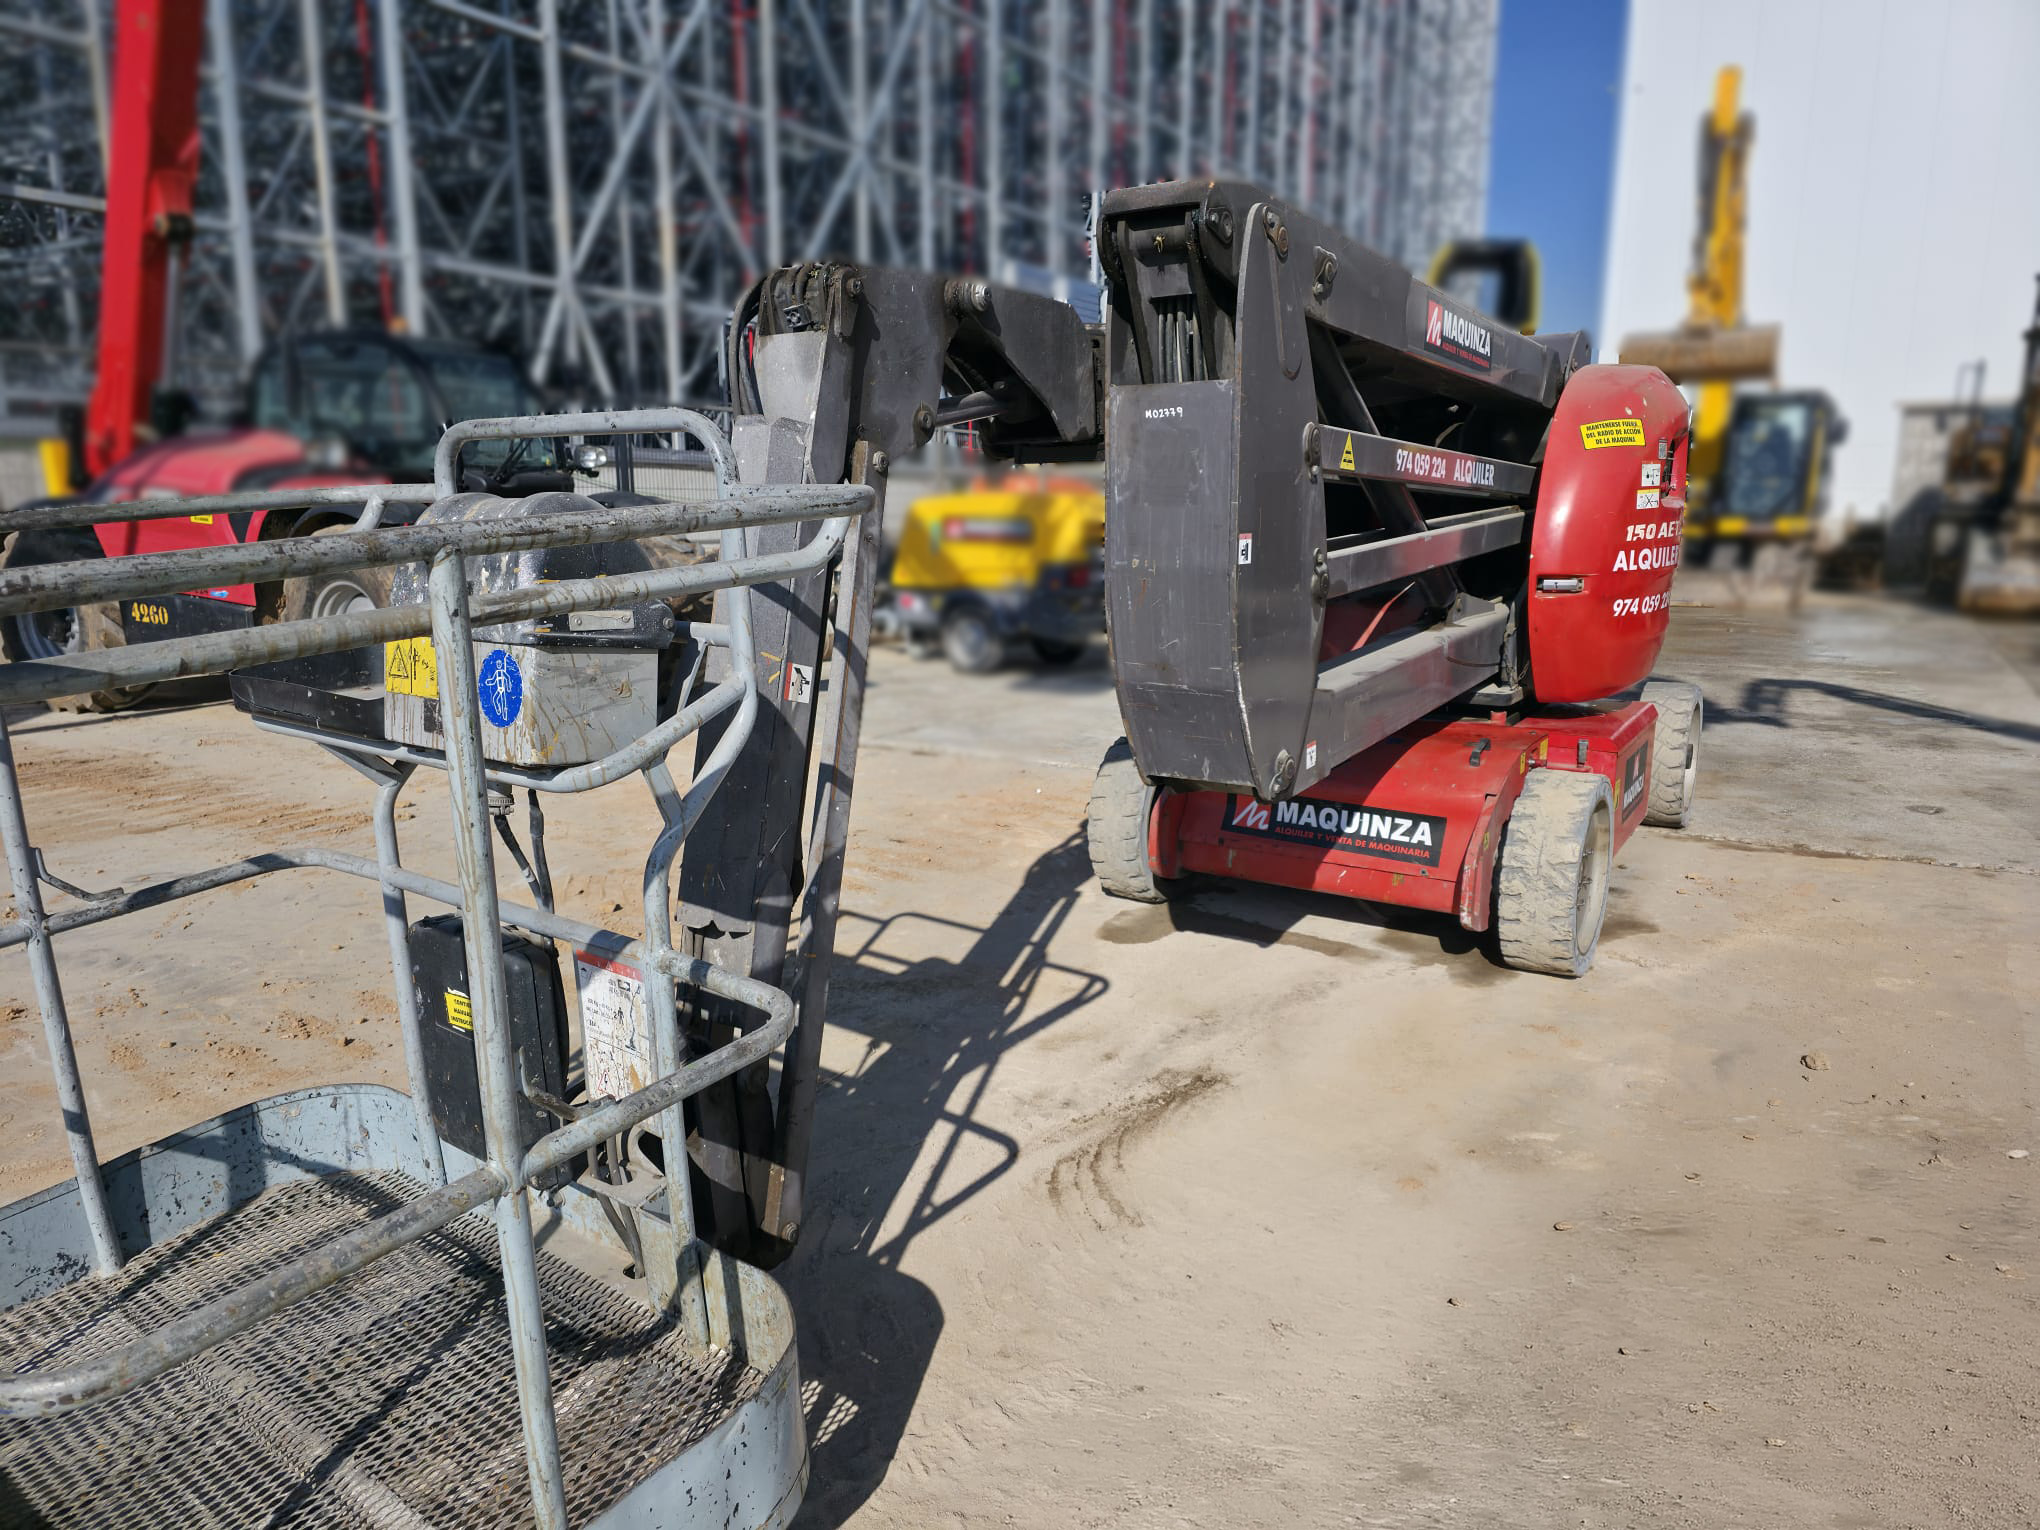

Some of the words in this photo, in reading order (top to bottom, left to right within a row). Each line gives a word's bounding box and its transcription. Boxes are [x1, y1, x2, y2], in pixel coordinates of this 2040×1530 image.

[1443, 309, 1491, 357] MAQUINZA
[1396, 449, 1412, 473] 974
[1414, 452, 1430, 476] 059
[1431, 455, 1446, 479] 224
[1453, 458, 1495, 487] ALQUILER
[1626, 523, 1657, 542] 150
[131, 601, 169, 625] 4260
[1613, 597, 1640, 616] 974
[1641, 593, 1660, 614] 059
[1276, 800, 1433, 847] MAQUINZA
[1355, 839, 1367, 848] DE
[1368, 841, 1430, 859] MAQUINARIA
